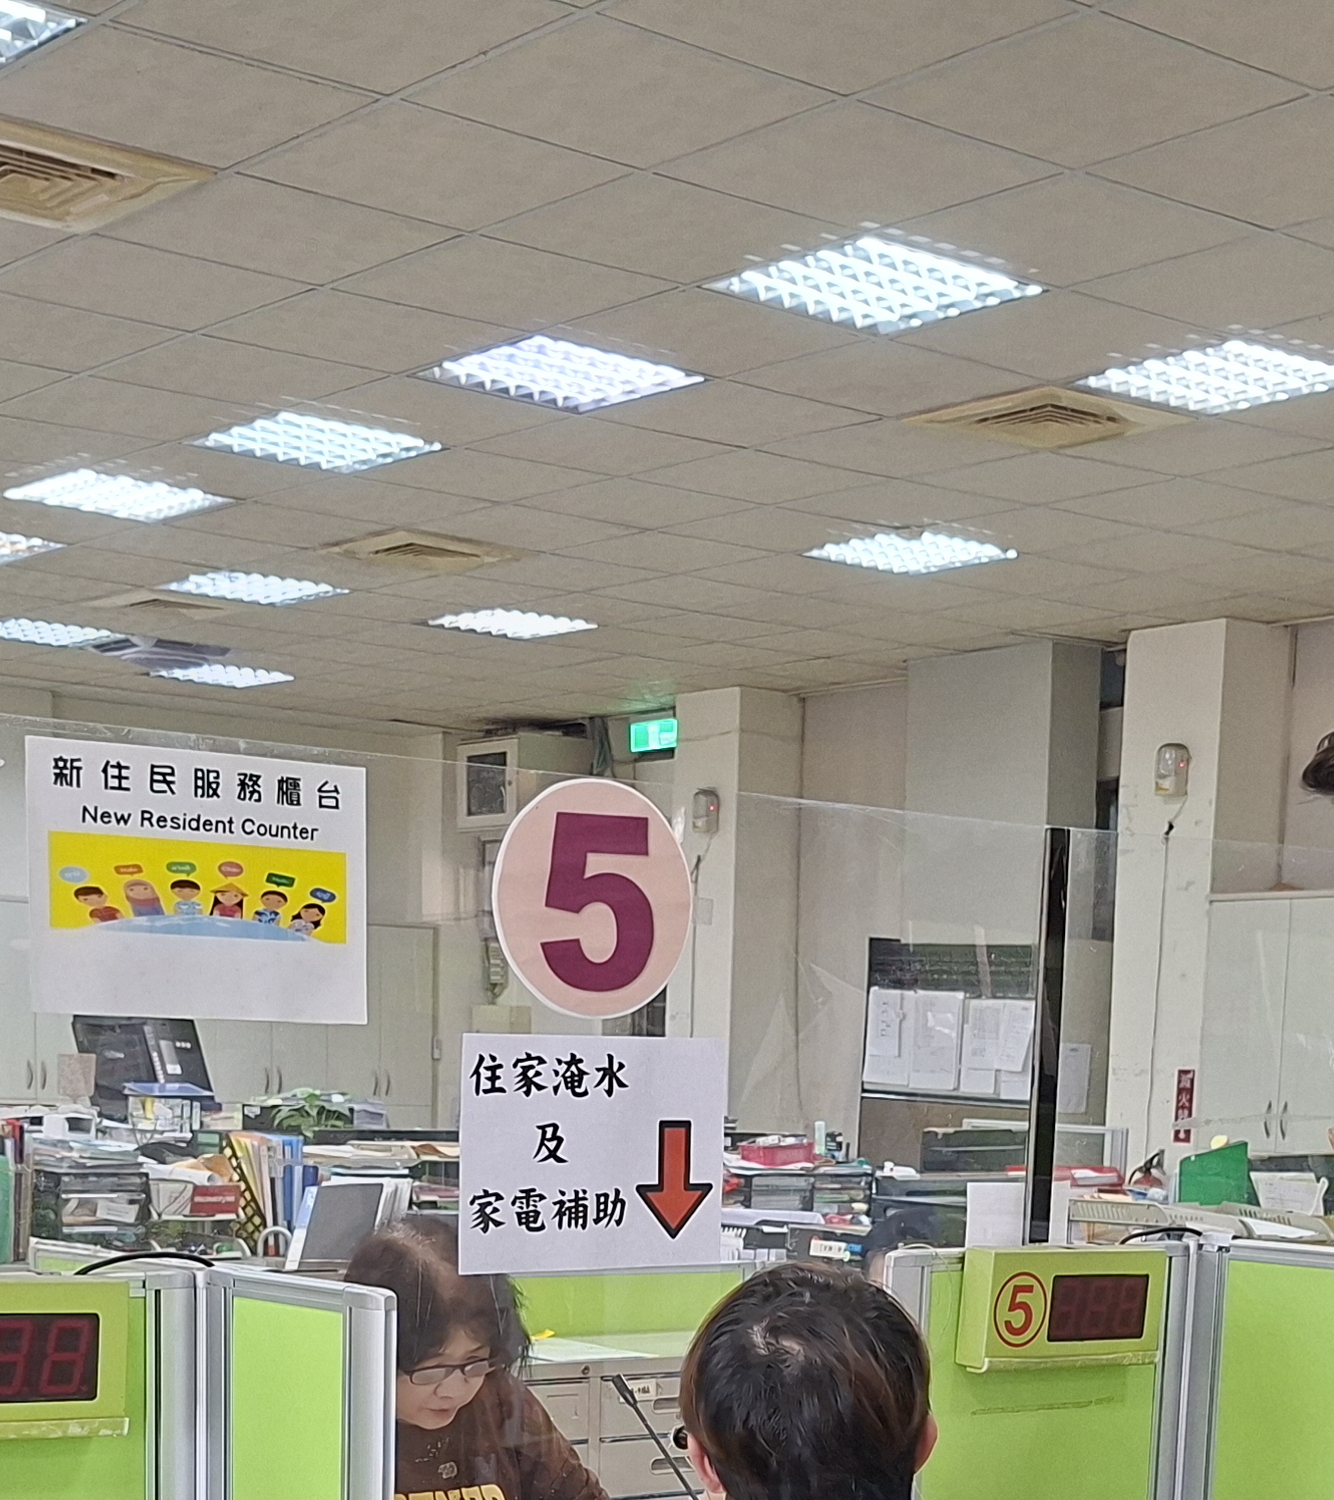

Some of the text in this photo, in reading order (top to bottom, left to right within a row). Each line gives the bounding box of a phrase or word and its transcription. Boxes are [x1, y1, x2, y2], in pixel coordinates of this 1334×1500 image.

[52, 755, 341, 810] 新住民服務櫃台
[81, 805, 319, 841] New Resident Counter
[540, 812, 654, 992] 5
[469, 1052, 629, 1098] 住家淹水
[533, 1122, 569, 1163] 及
[468, 1187, 627, 1233] 家電補助
[1004, 1285, 1034, 1336] 5
